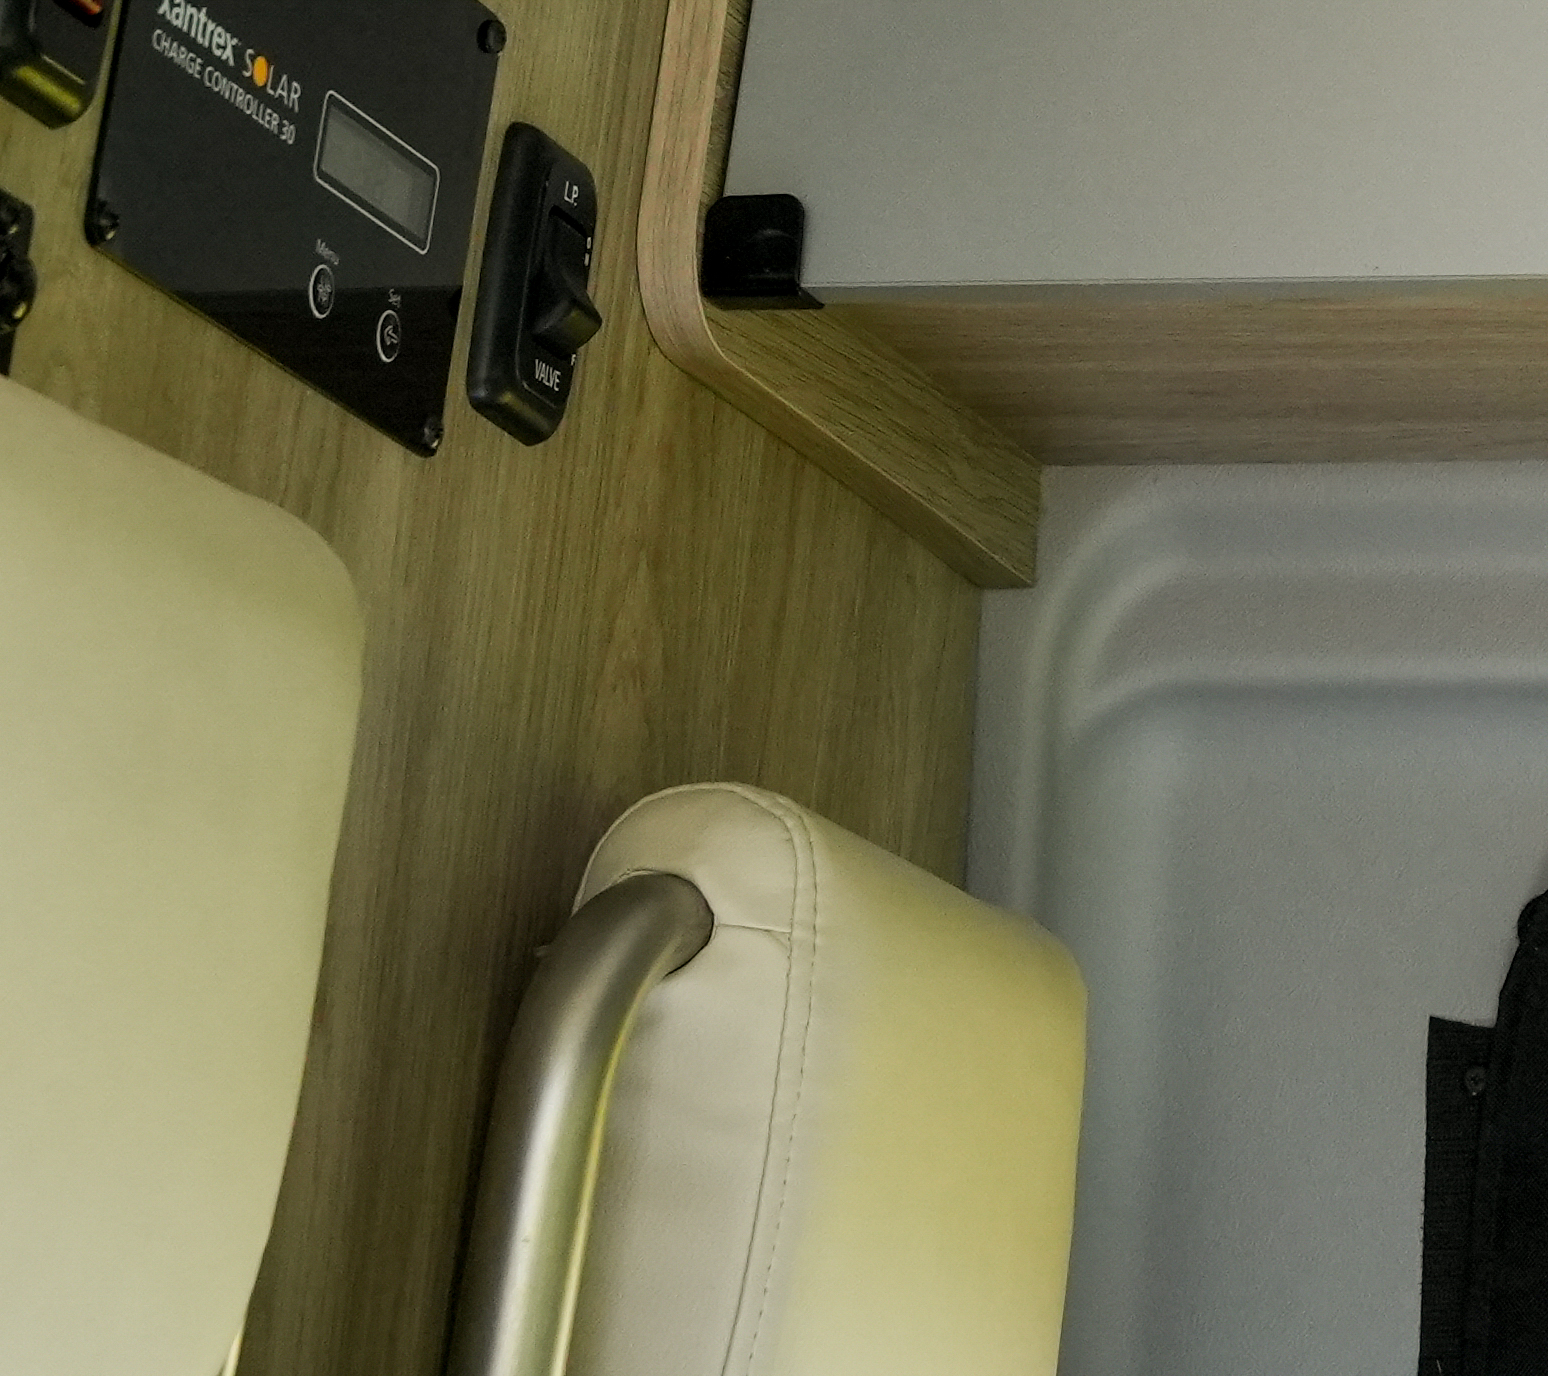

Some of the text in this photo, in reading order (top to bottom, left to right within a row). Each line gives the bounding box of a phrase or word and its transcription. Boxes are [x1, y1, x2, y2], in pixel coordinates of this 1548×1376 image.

[151, 28, 297, 145] CHARGE CONTROLLER 30
[534, 358, 562, 392] VALVE
